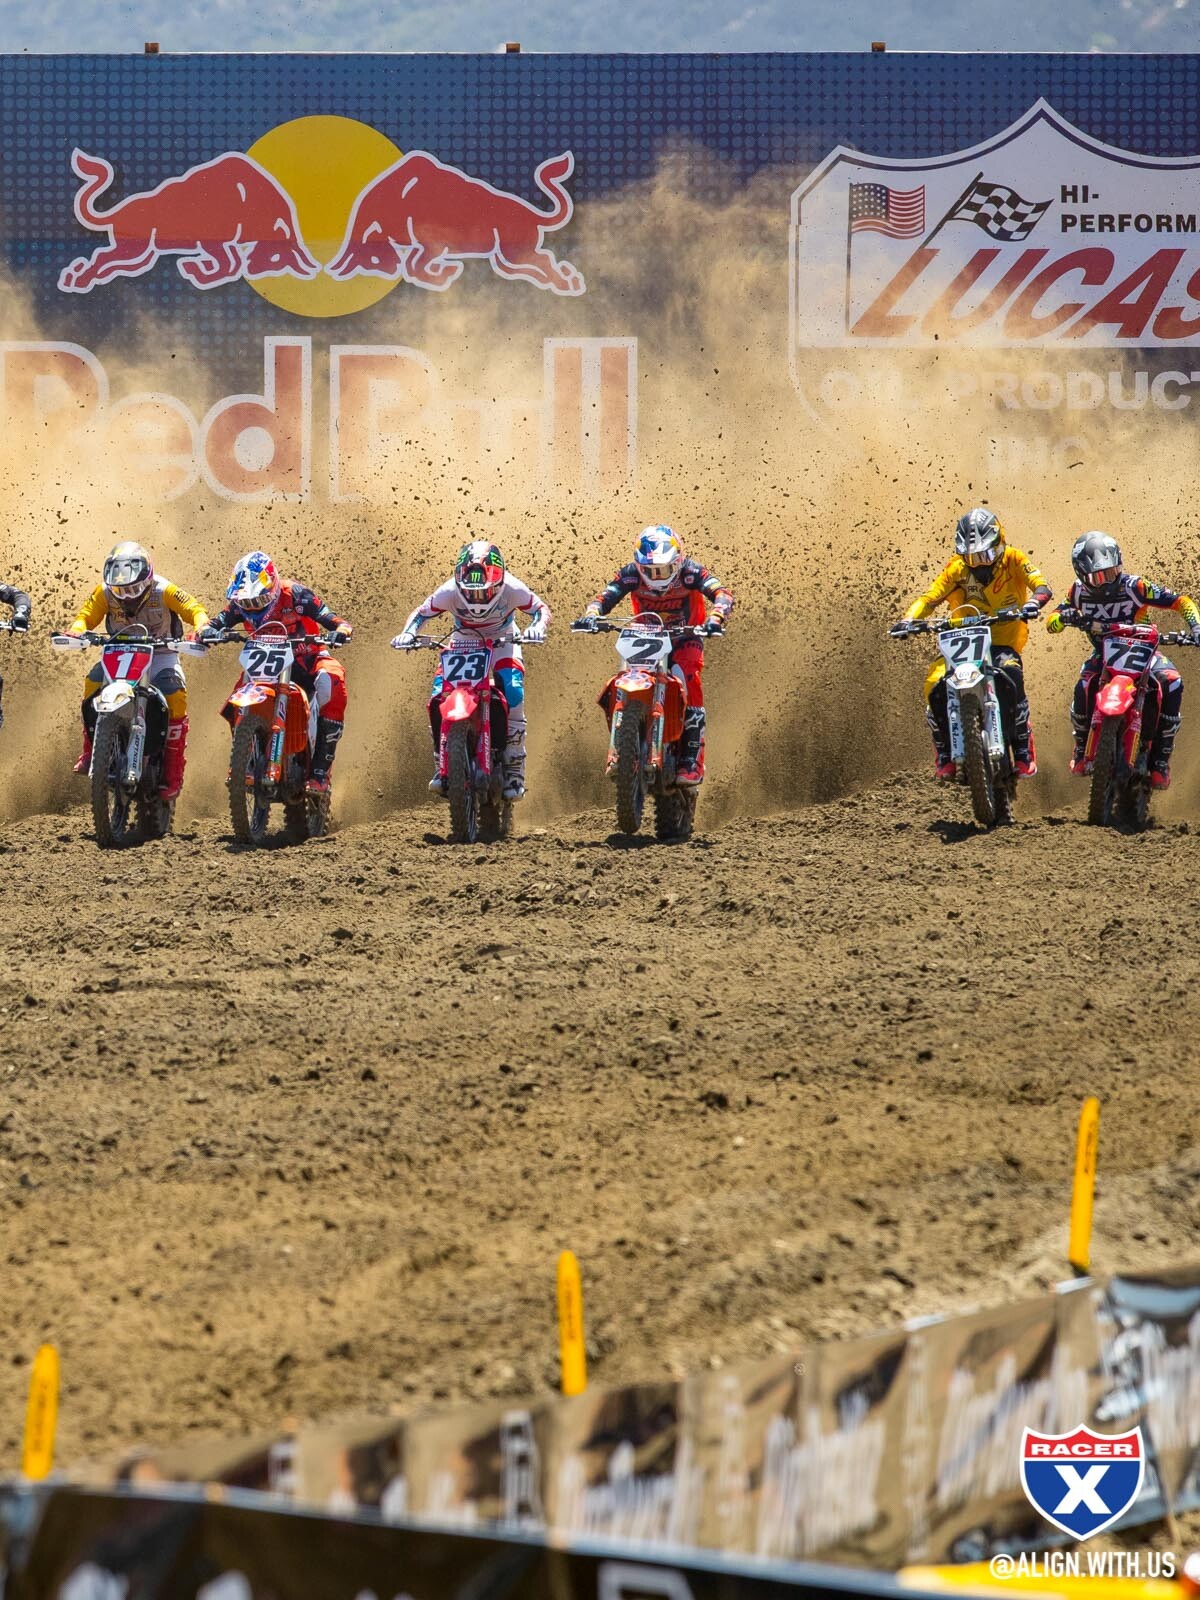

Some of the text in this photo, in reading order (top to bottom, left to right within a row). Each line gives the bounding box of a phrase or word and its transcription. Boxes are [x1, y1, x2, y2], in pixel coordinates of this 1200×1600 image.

[1061, 185, 1099, 203] HI-
[1061, 214, 1200, 233] PERFORM
[944, 370, 1200, 410] PRODUC
[1081, 600, 1135, 620] FXR
[626, 638, 664, 665] 2
[950, 635, 985, 663] 21
[1107, 642, 1154, 672] 72
[115, 652, 135, 679] 1
[246, 650, 287, 677] 25
[446, 654, 486, 682] 23
